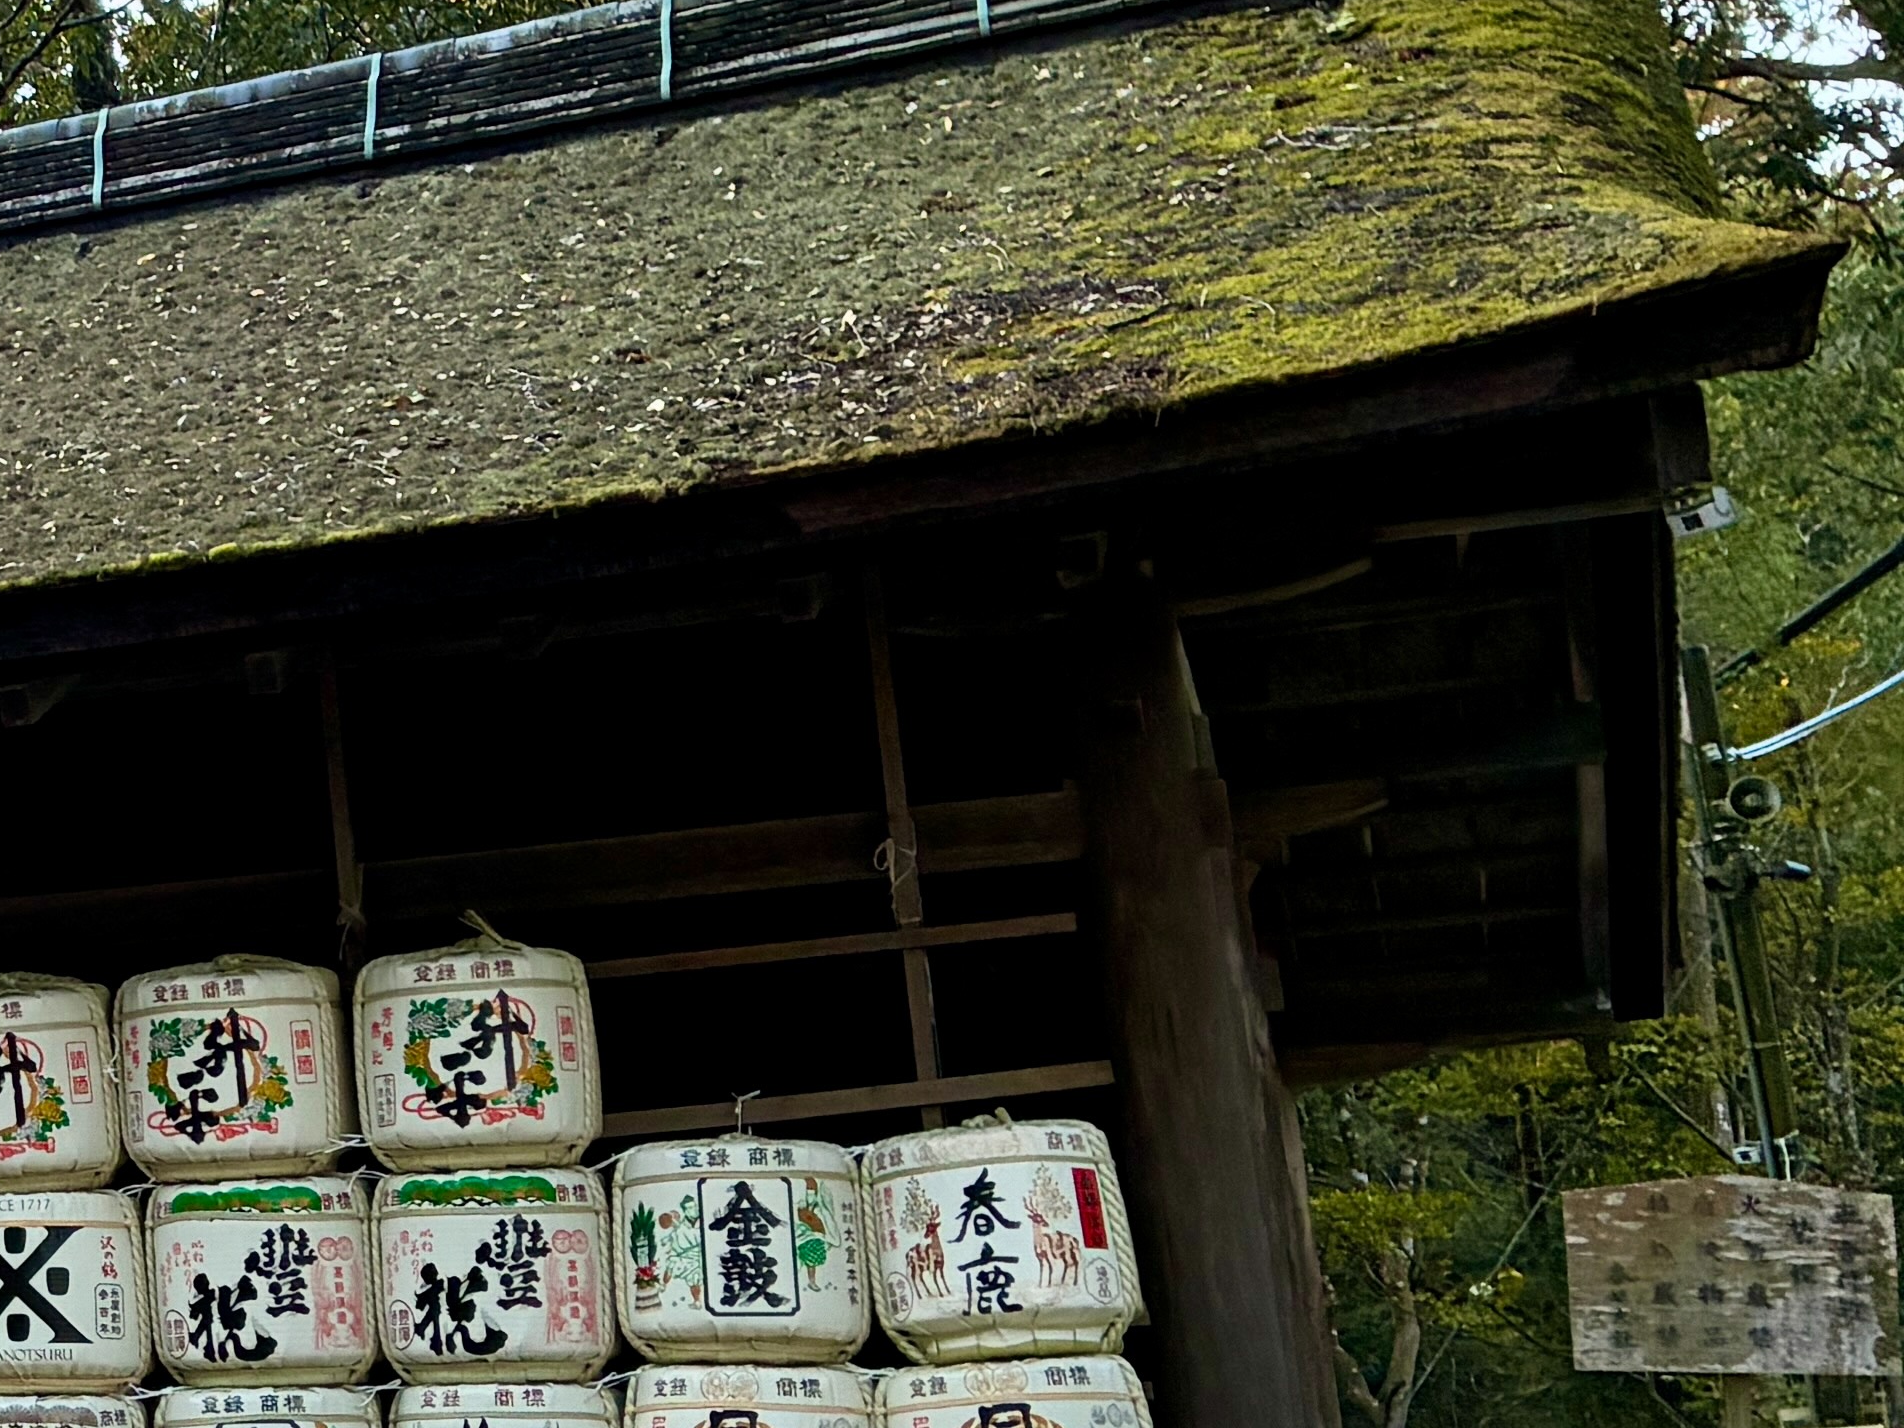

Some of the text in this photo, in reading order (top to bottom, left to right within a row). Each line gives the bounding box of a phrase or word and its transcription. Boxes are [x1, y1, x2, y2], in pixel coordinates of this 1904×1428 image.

[20, 1198, 51, 1212] 1717
[100, 1235, 119, 1280] 沢の鶴
[947, 1166, 1024, 1317] 春鹿
